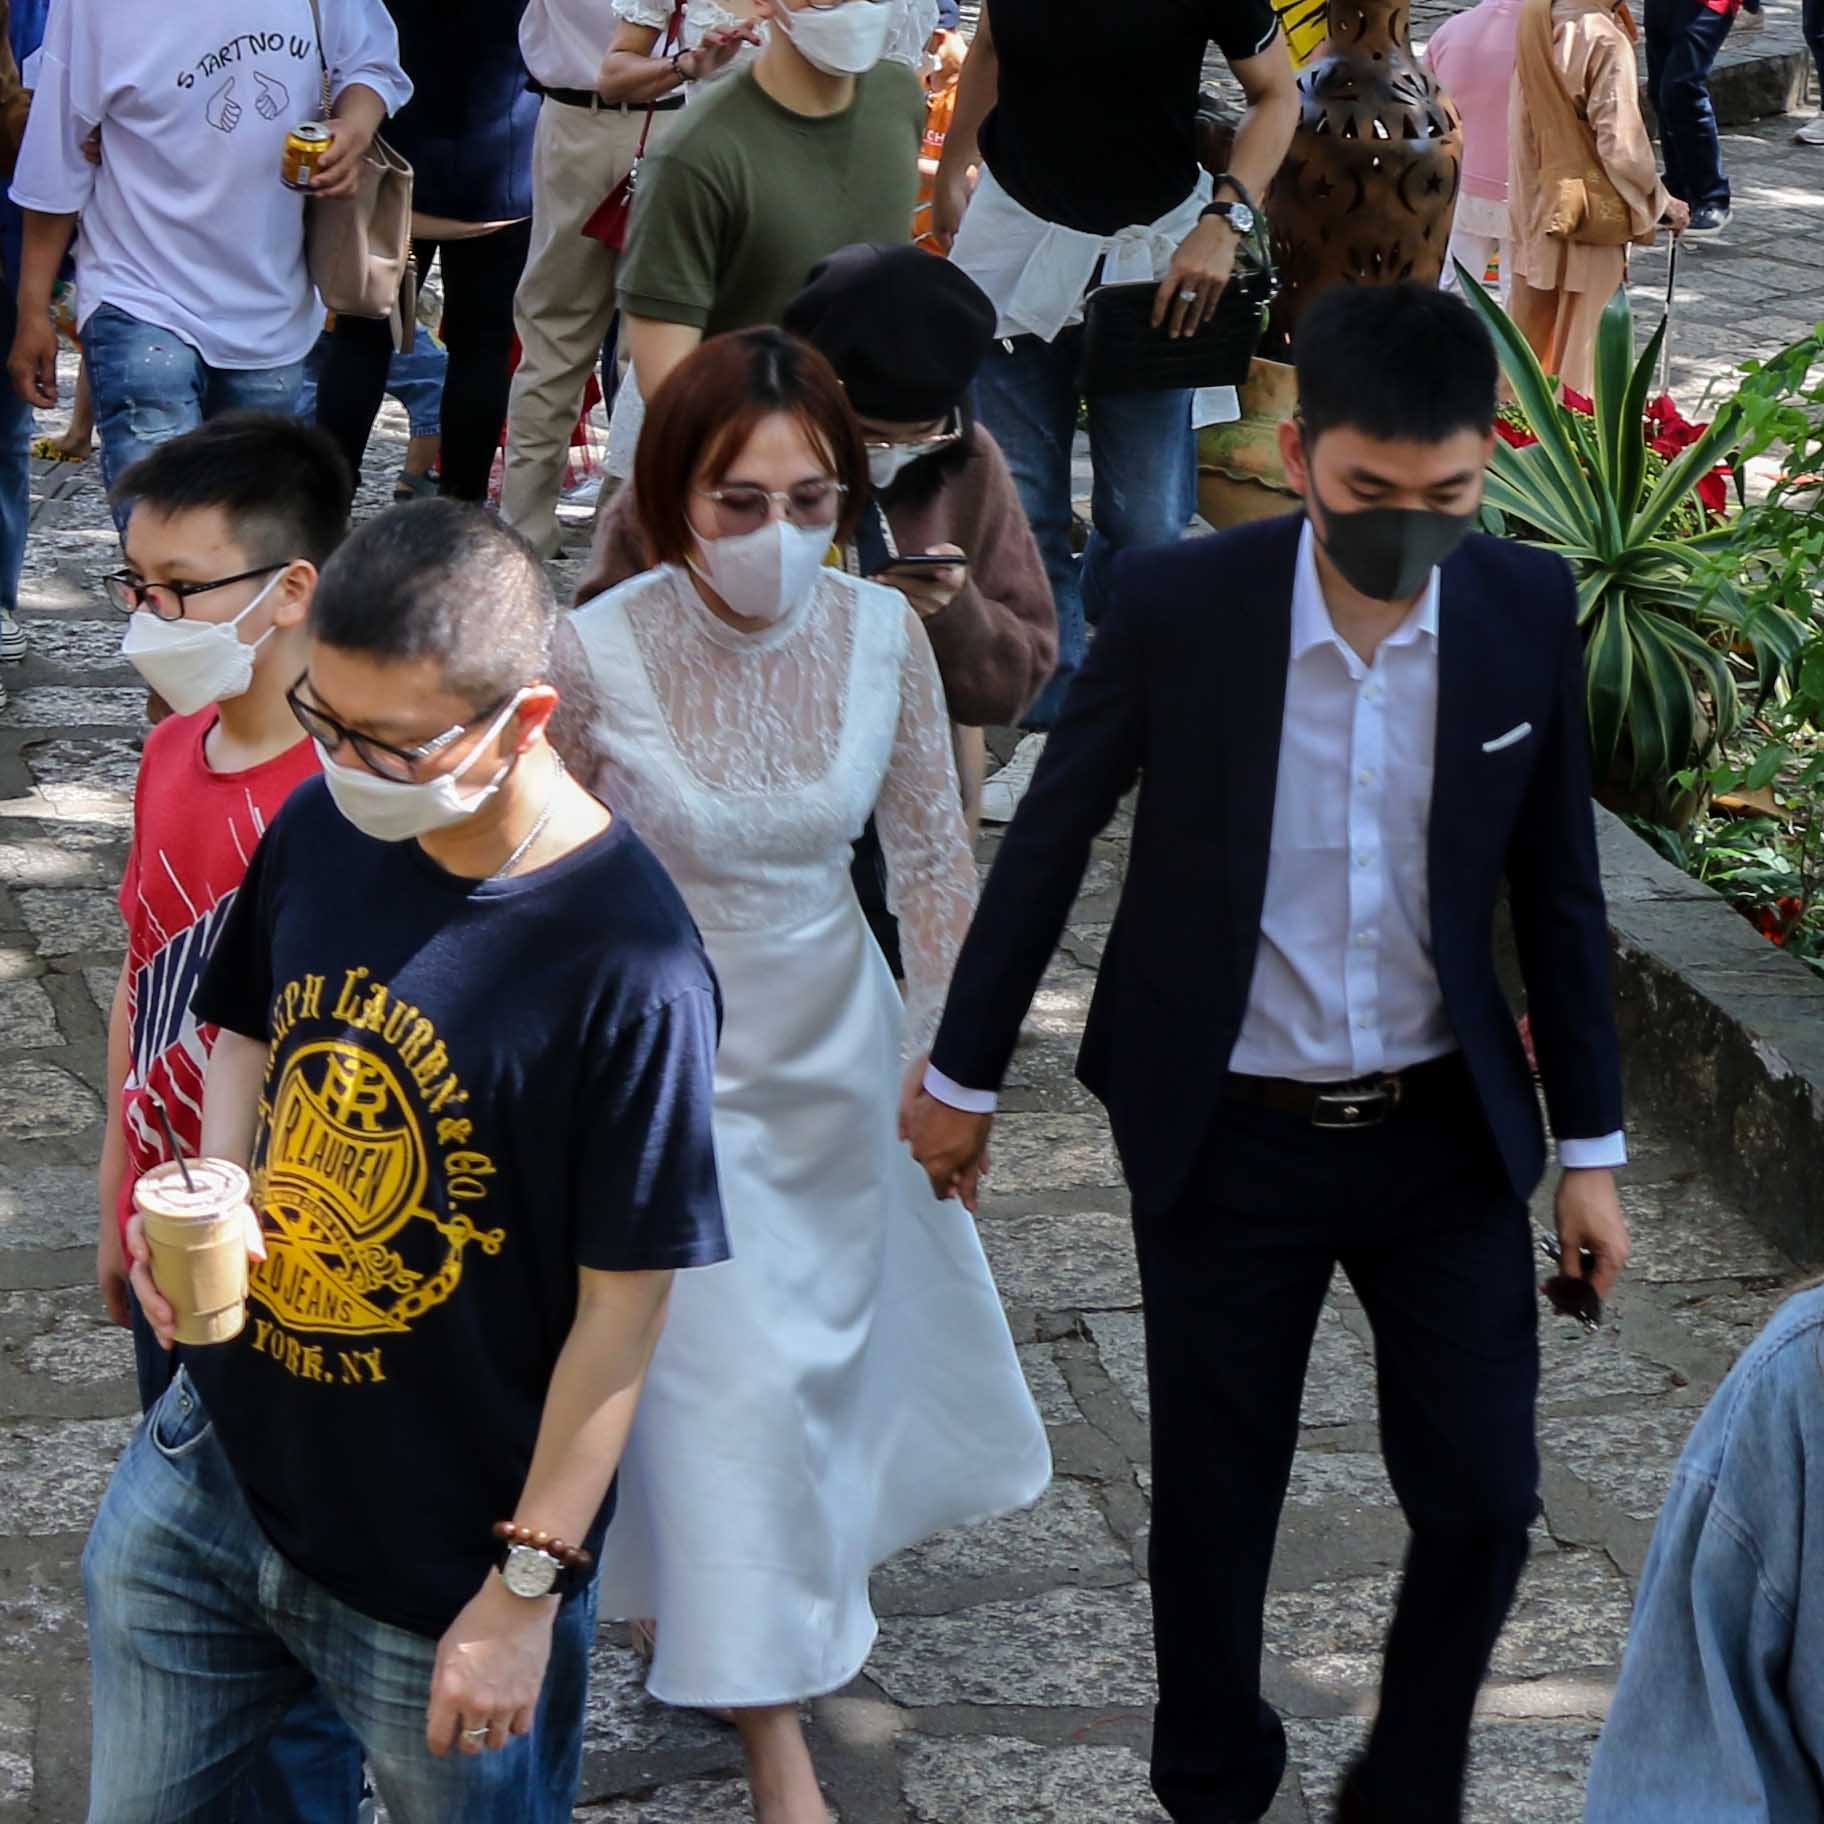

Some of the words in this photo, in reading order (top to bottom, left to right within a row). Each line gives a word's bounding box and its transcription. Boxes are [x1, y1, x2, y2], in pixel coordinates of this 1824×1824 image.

[177, 35, 249, 89] START
[249, 32, 311, 60] NOW
[332, 966, 469, 1113] LAUREN
[436, 1117, 473, 1145] &
[283, 1263, 353, 1323] JEANS
[339, 1347, 387, 1383] NY
